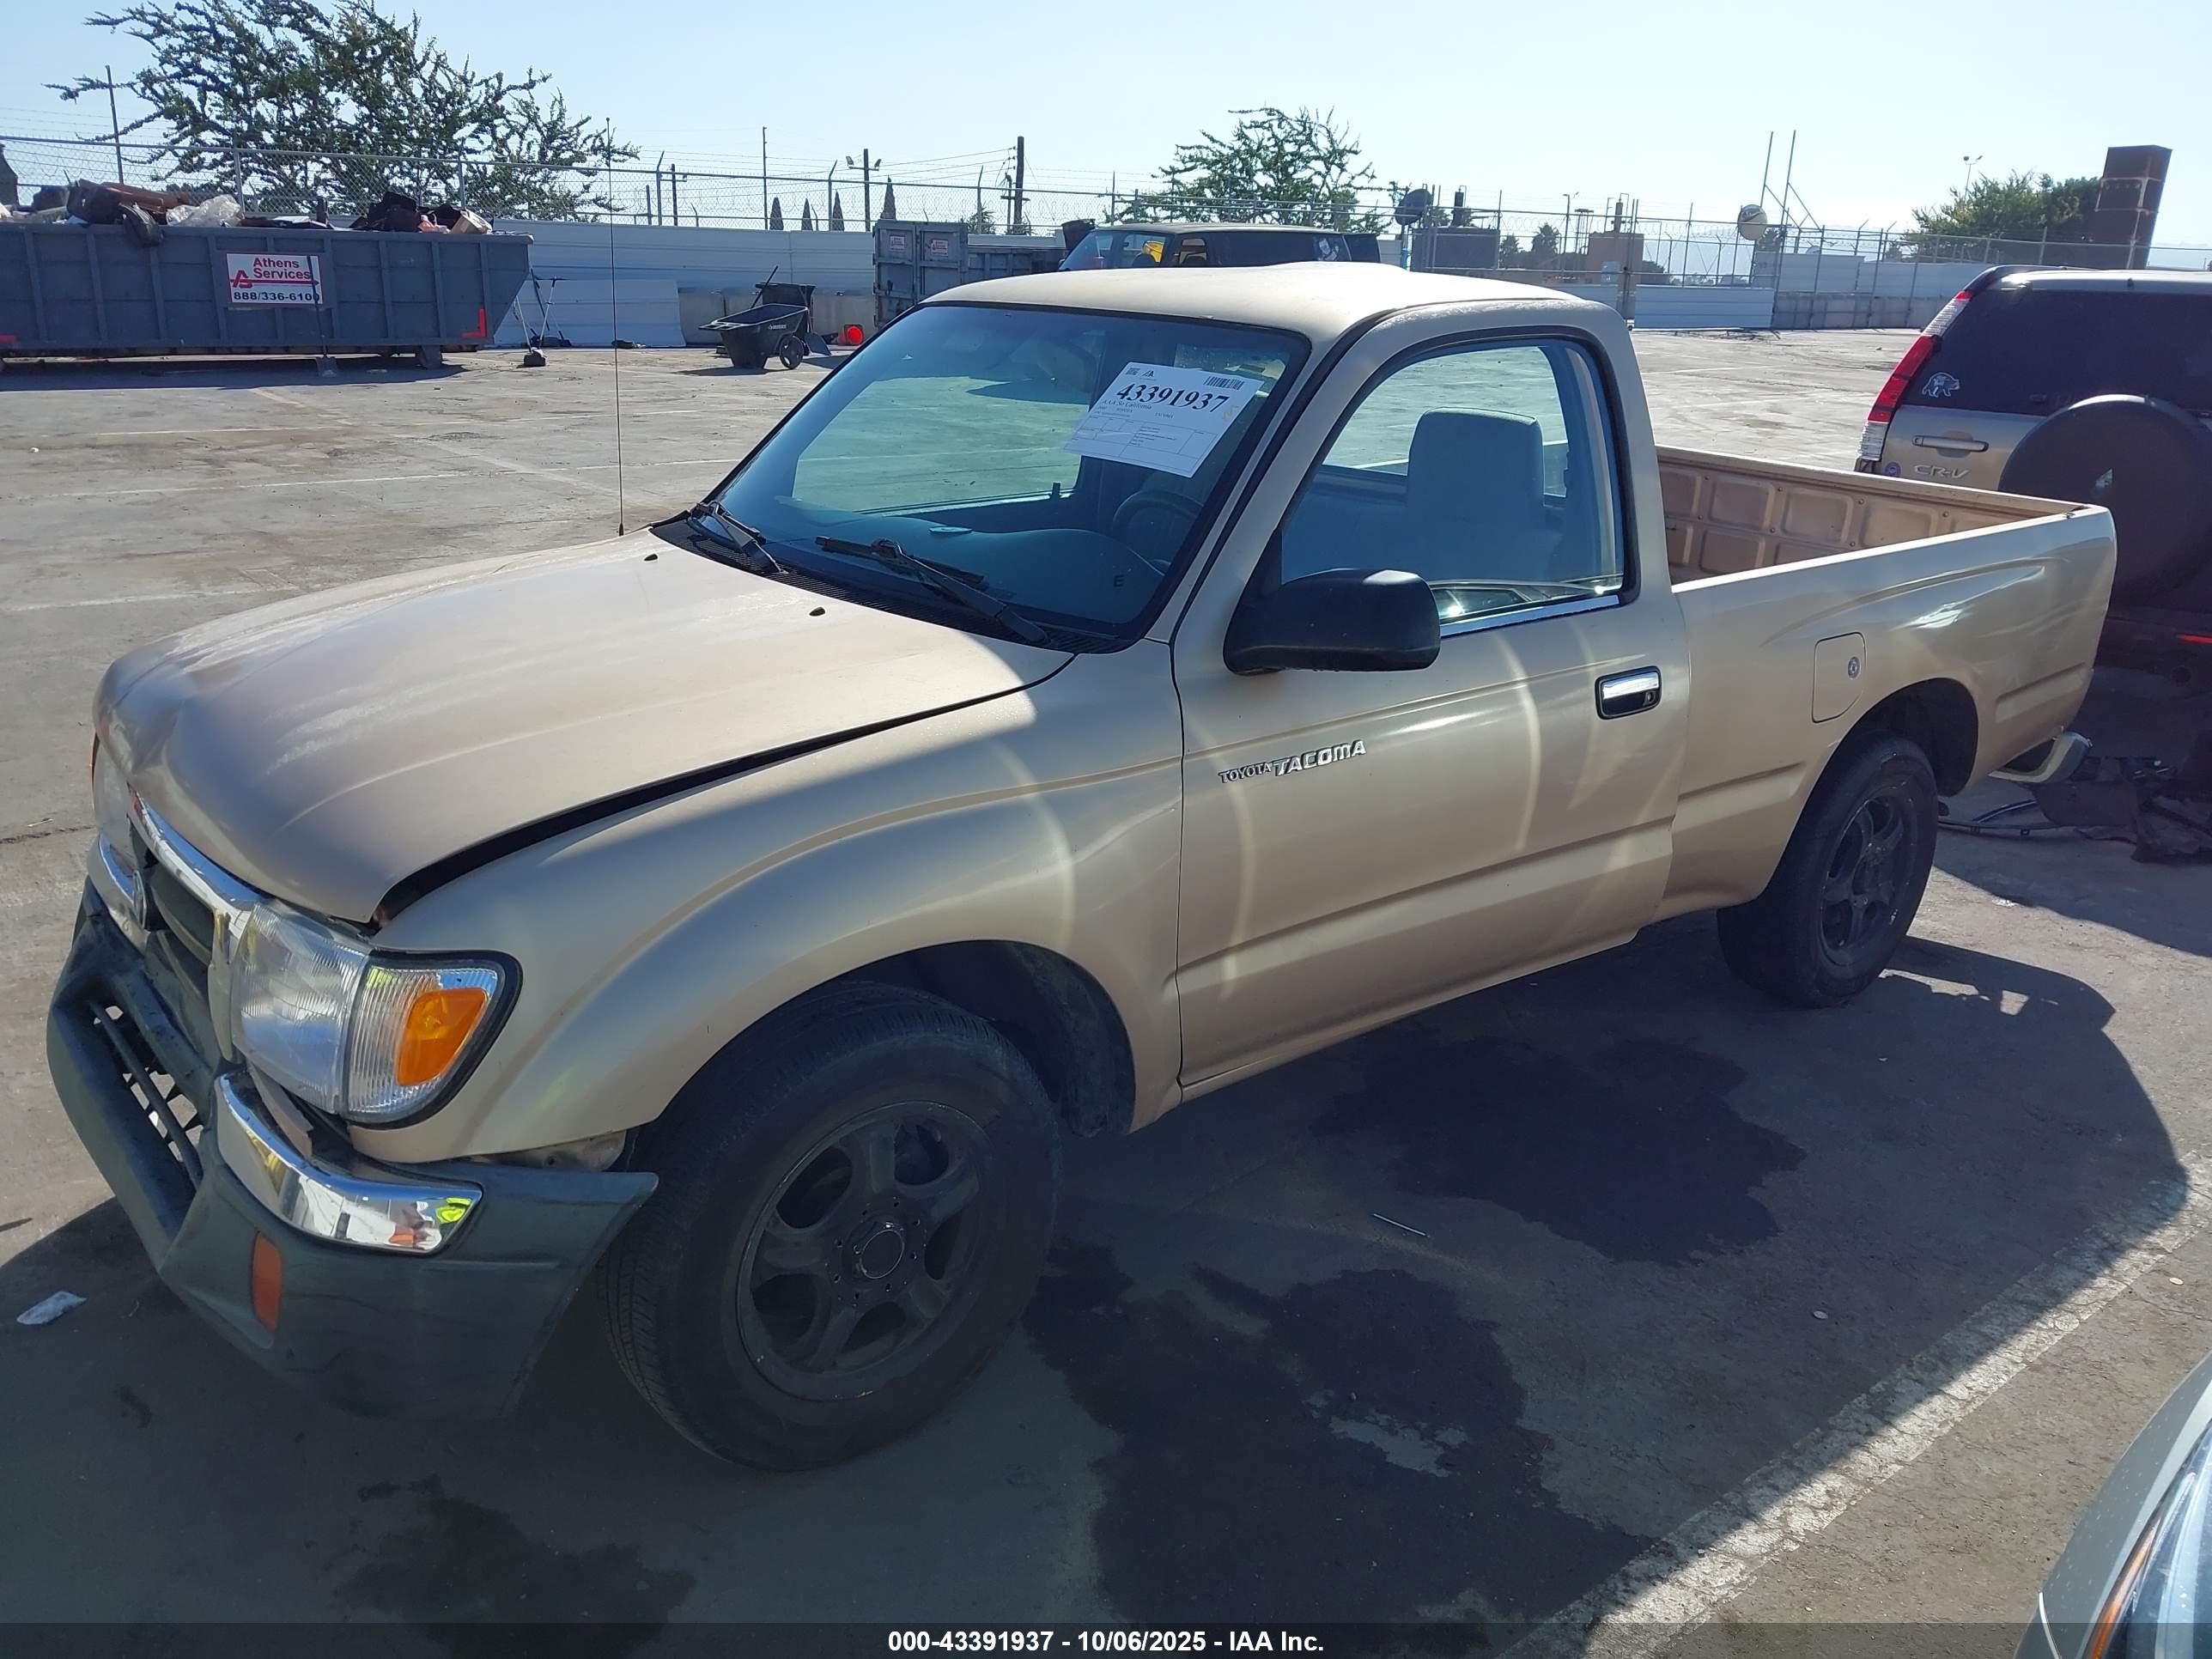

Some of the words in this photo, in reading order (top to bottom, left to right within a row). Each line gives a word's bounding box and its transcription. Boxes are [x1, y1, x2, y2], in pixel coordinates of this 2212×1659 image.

[253, 258, 300, 268] Athens
[253, 268, 312, 280] Services
[234, 292, 319, 301] 888/336-6100
[1117, 383, 1231, 412] 43391937
[1914, 465, 1970, 478] CR-V
[1218, 762, 1273, 783] TOYOTA
[1272, 739, 1367, 777] TACOMA
